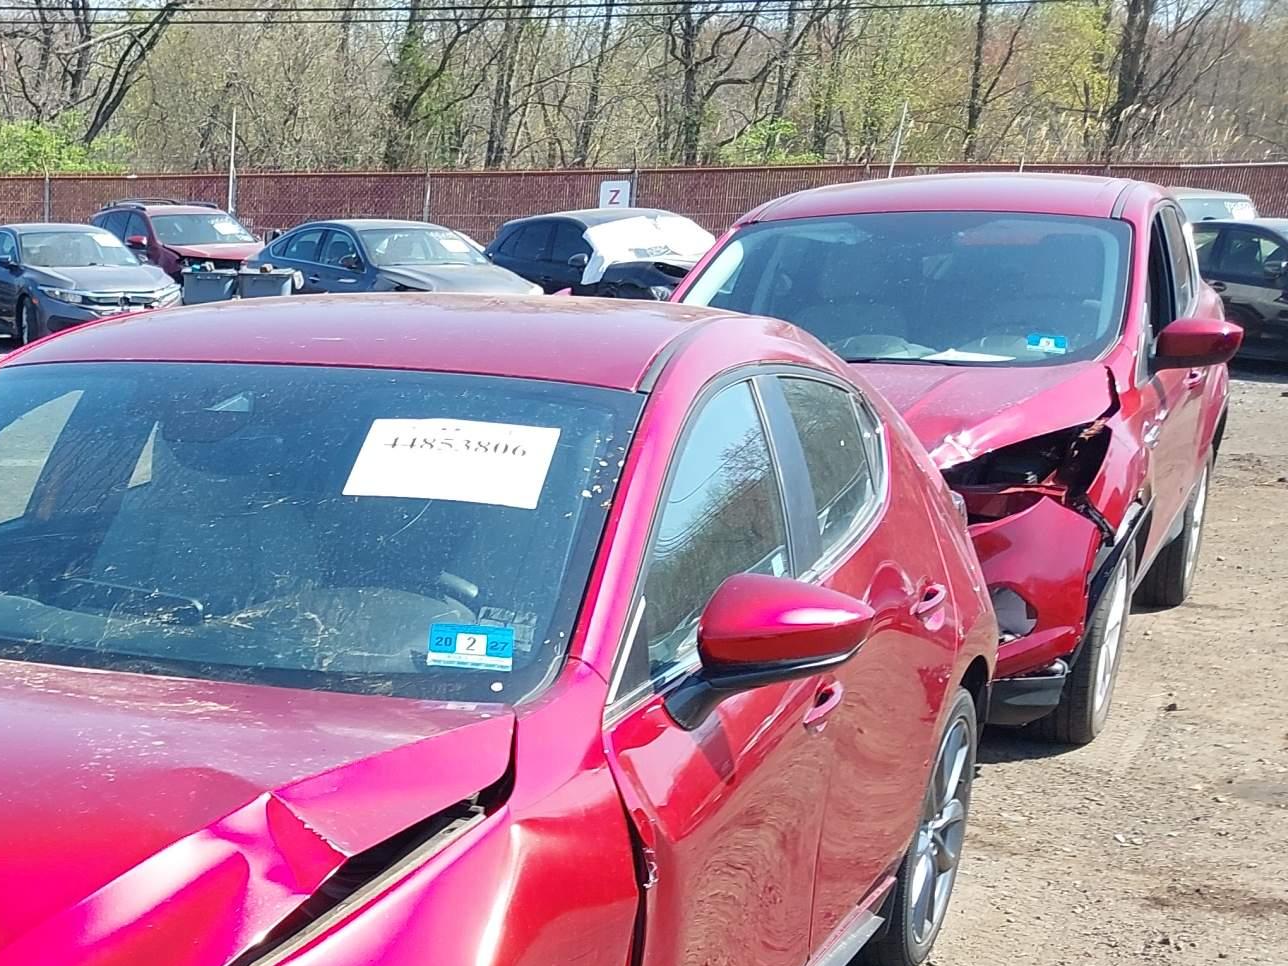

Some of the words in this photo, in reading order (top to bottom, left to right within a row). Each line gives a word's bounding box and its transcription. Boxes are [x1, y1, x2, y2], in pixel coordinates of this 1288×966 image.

[608, 189, 621, 205] Z
[383, 436, 528, 458] 44853806
[434, 636, 453, 647] 20
[465, 636, 478, 652] 2
[489, 640, 510, 653] 27
